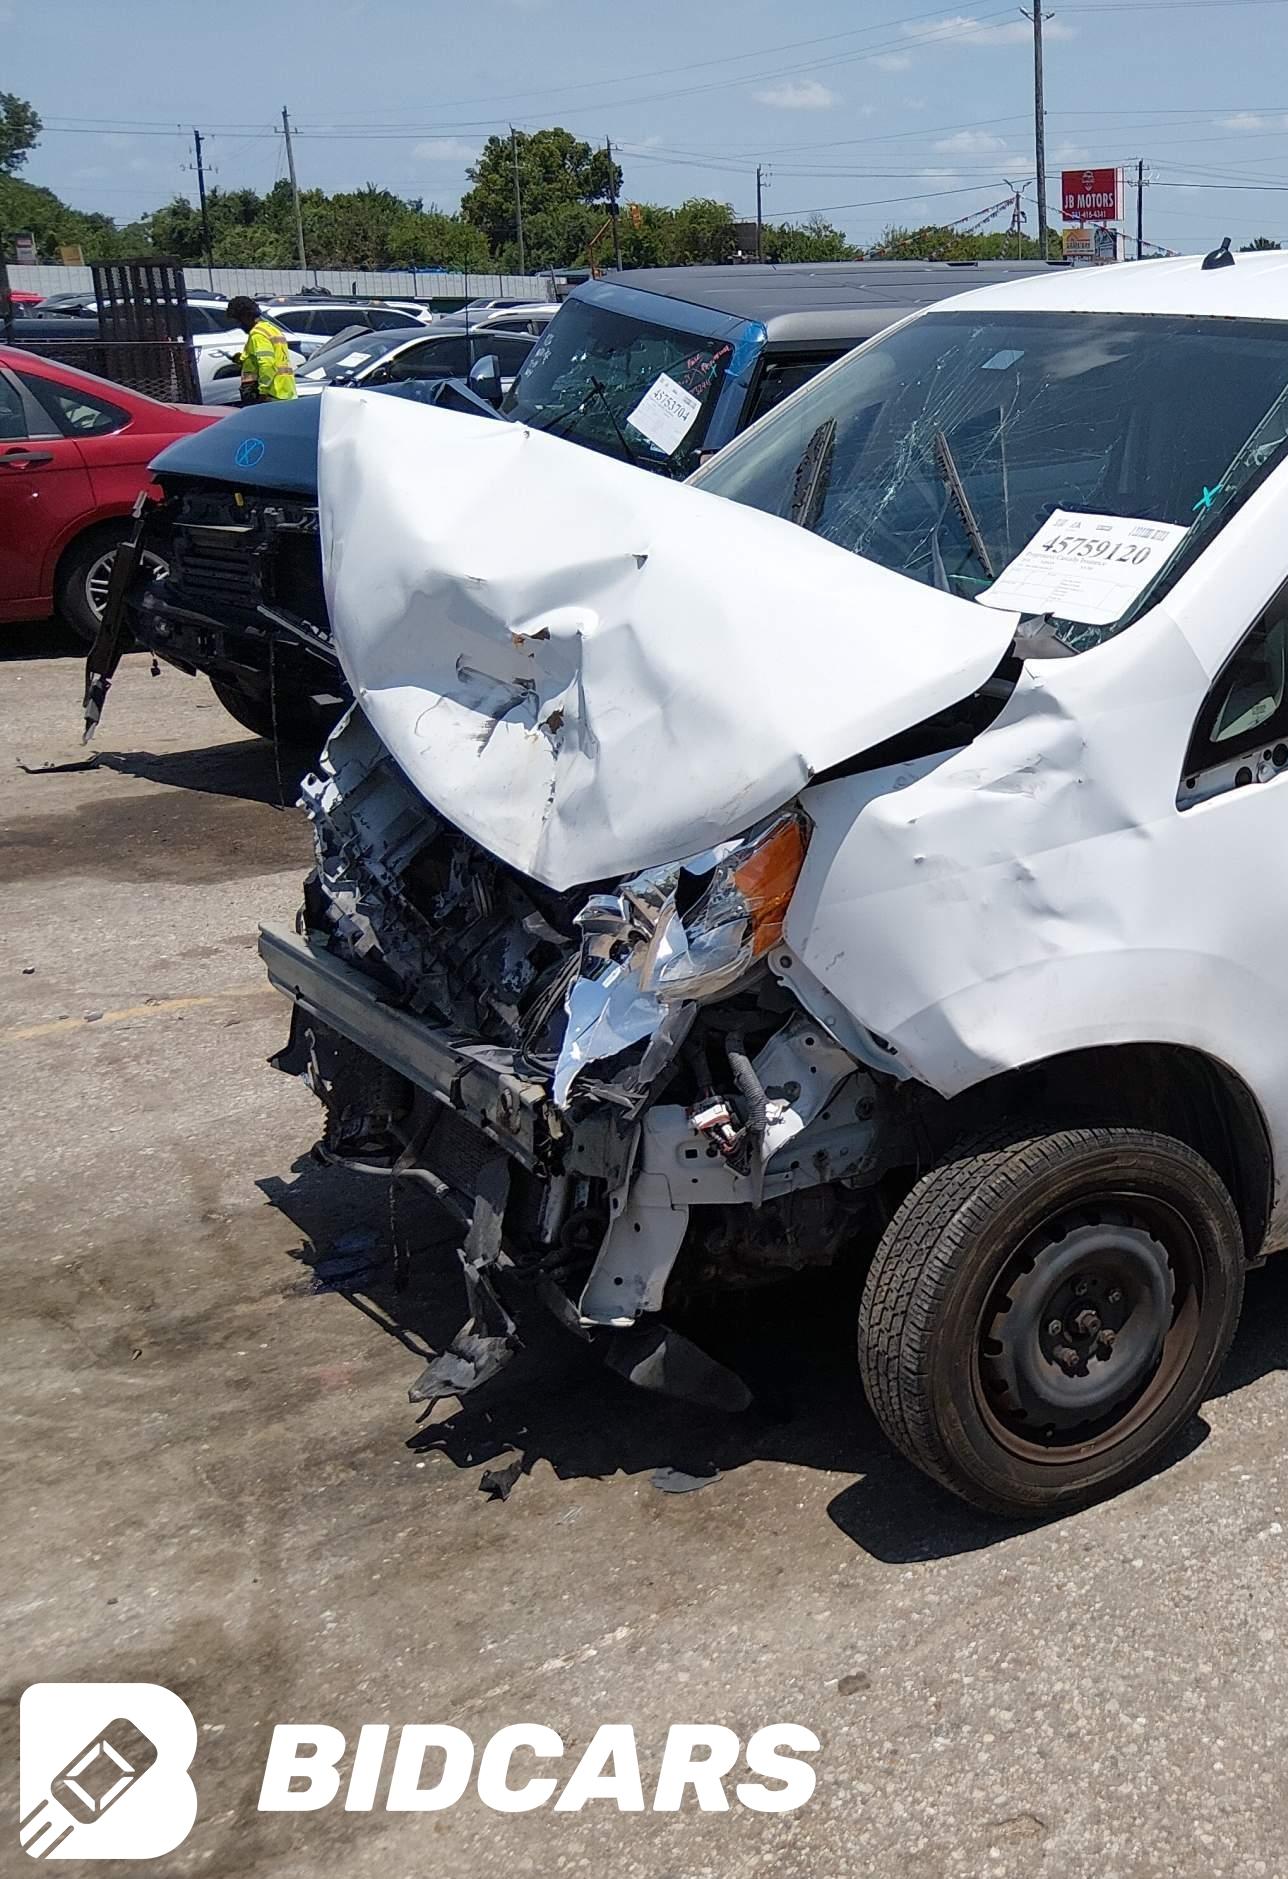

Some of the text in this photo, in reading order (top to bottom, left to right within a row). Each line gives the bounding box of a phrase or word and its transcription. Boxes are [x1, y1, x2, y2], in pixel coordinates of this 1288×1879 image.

[1064, 192, 1114, 210] JB MOTORS
[1042, 535, 1151, 566] 45759120
